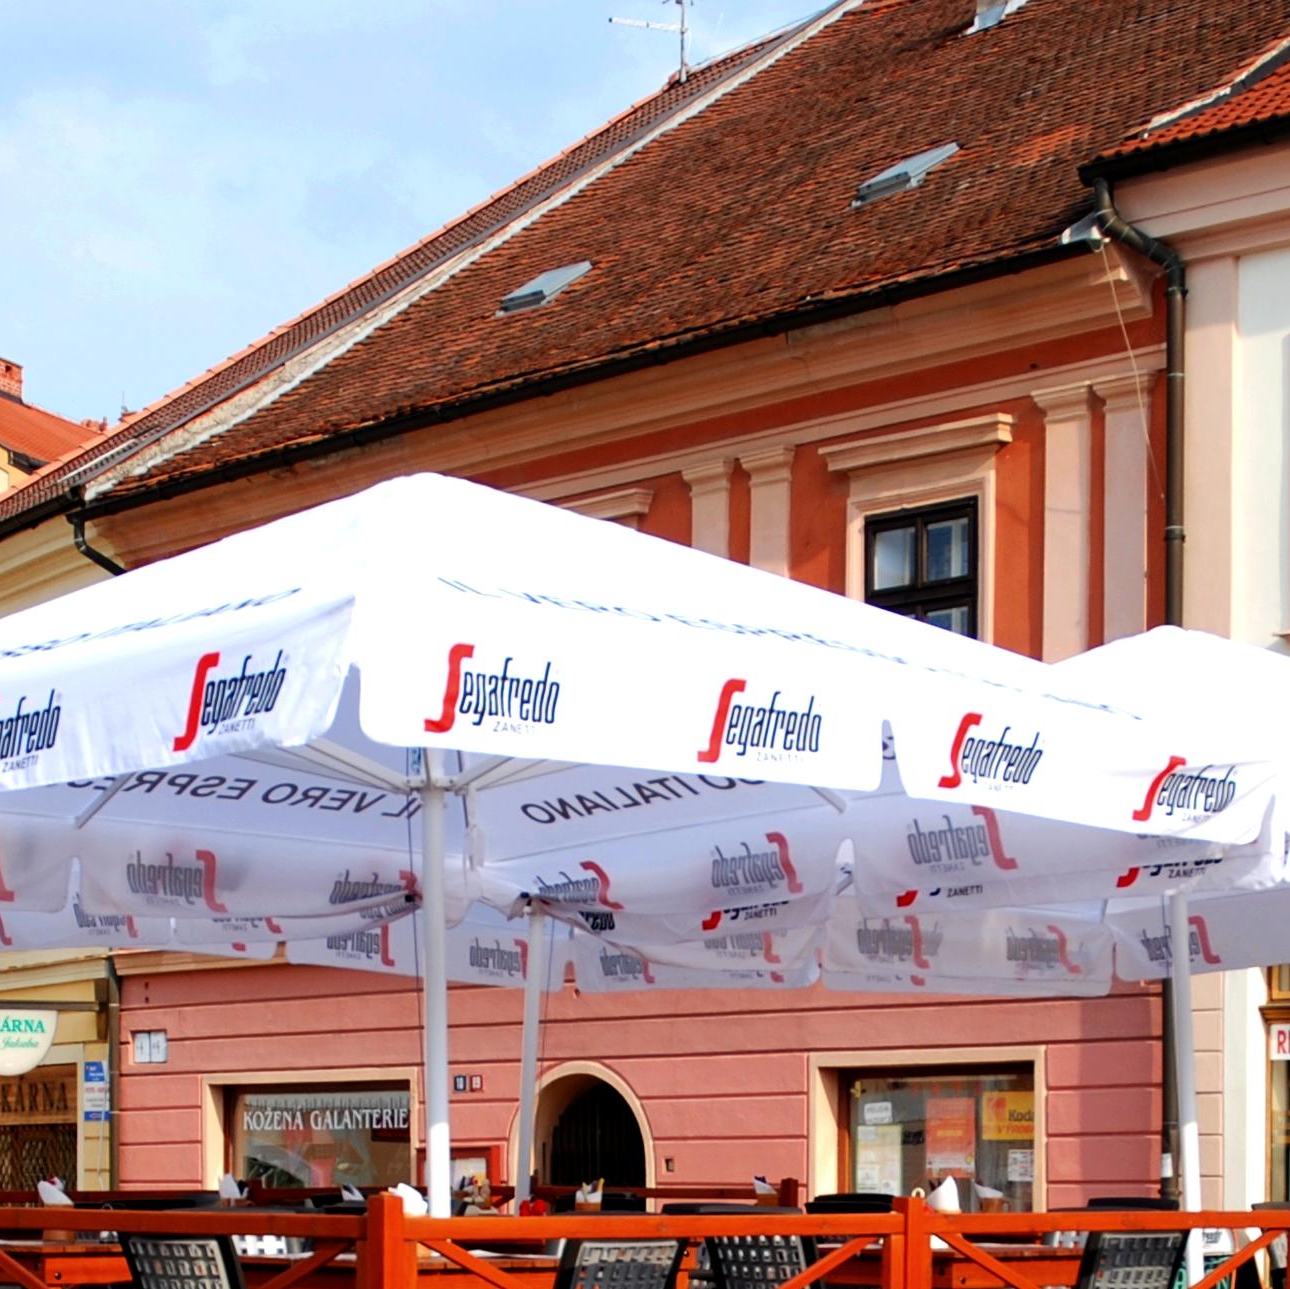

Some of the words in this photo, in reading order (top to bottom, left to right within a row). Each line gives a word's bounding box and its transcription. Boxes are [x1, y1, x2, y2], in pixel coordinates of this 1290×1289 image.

[172, 649, 287, 752] Segafredo
[424, 643, 560, 733] Segafredo
[218, 720, 255, 735] ZANETTI
[697, 678, 822, 763] Segafredo
[2, 754, 39, 773] ZANETTI
[938, 712, 1044, 789] Segafredo
[1132, 755, 1236, 822] Segafredo
[1169, 867, 1206, 878] ZANETTI
[946, 885, 983, 897] ZANETTI
[744, 907, 777, 919] ZANETTI
[243, 1105, 304, 1131] KOŽENÁ
[310, 1108, 409, 1130] GALANTERIE
